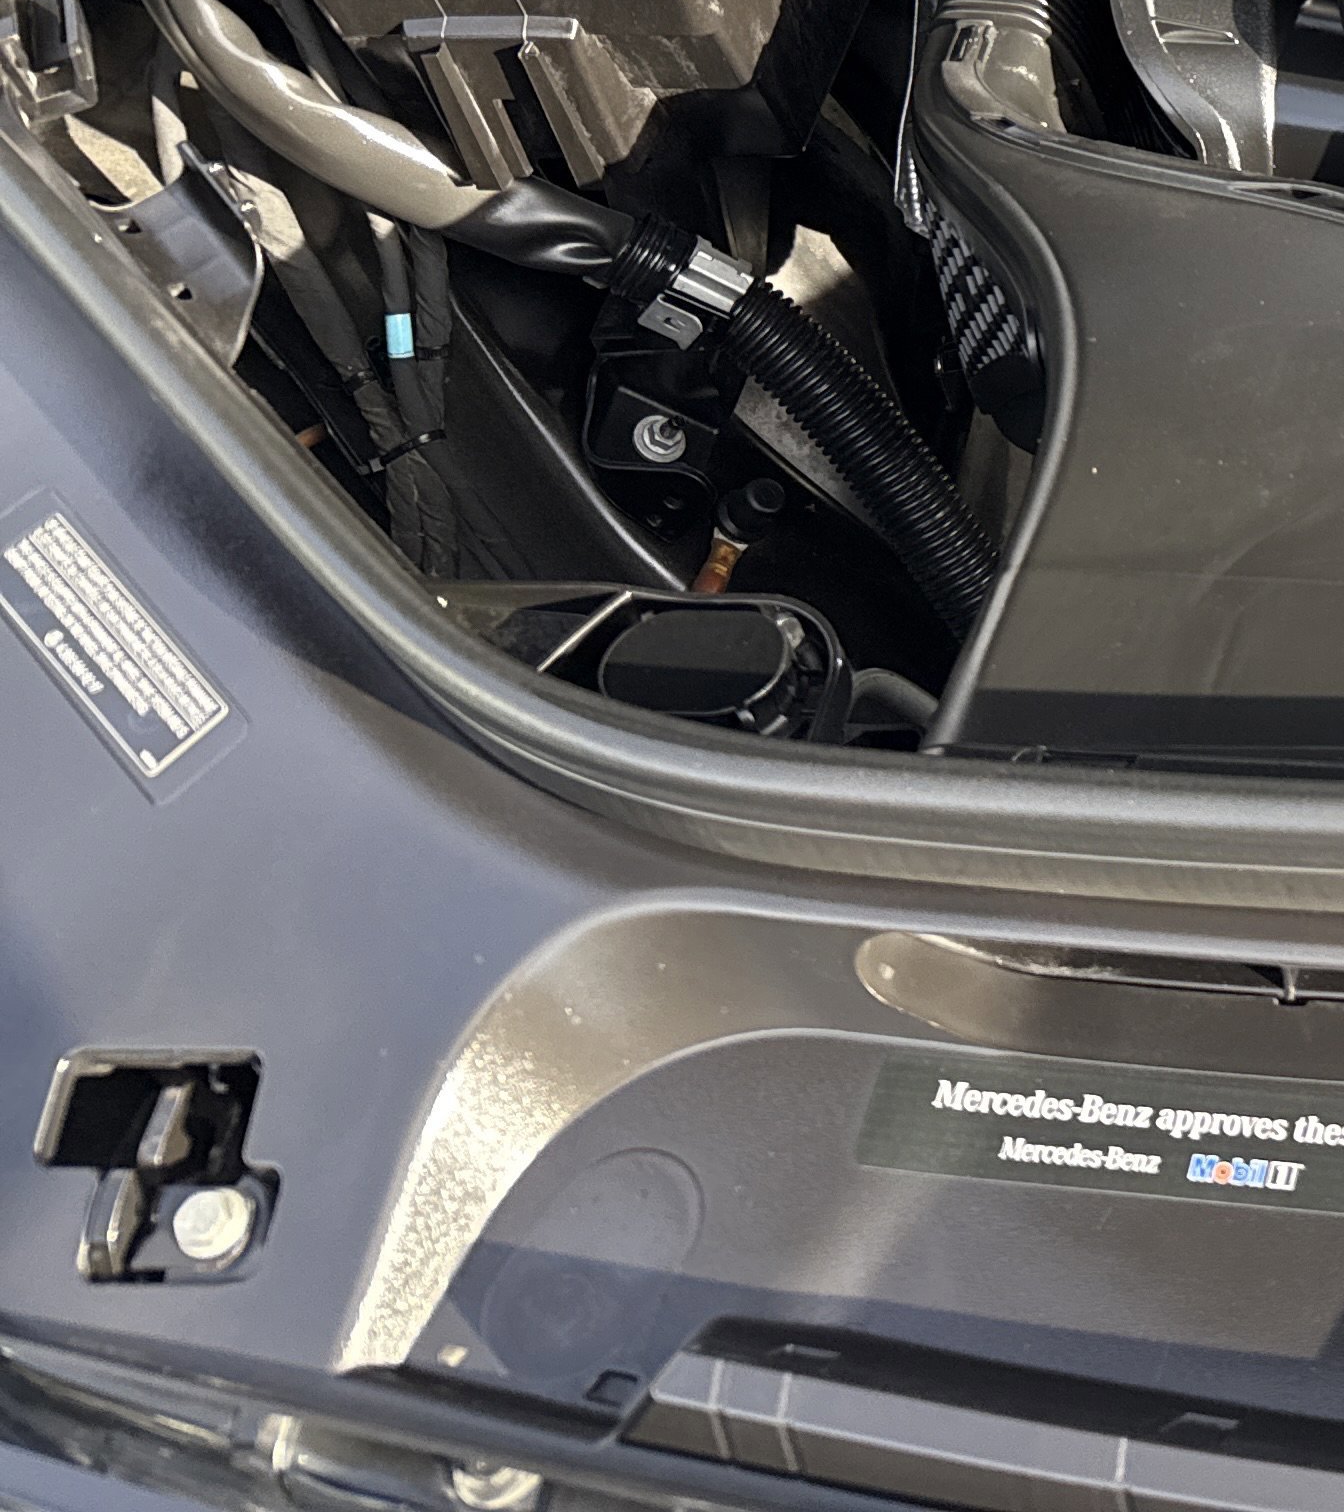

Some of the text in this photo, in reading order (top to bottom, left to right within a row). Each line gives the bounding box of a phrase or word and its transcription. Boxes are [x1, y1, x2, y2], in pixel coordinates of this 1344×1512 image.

[931, 1079, 1152, 1129] Mercedes-Benz
[1155, 1110, 1289, 1143] approves
[998, 1135, 1162, 1175] Mercedes-Benz
[1187, 1153, 1267, 1190] Mobil
